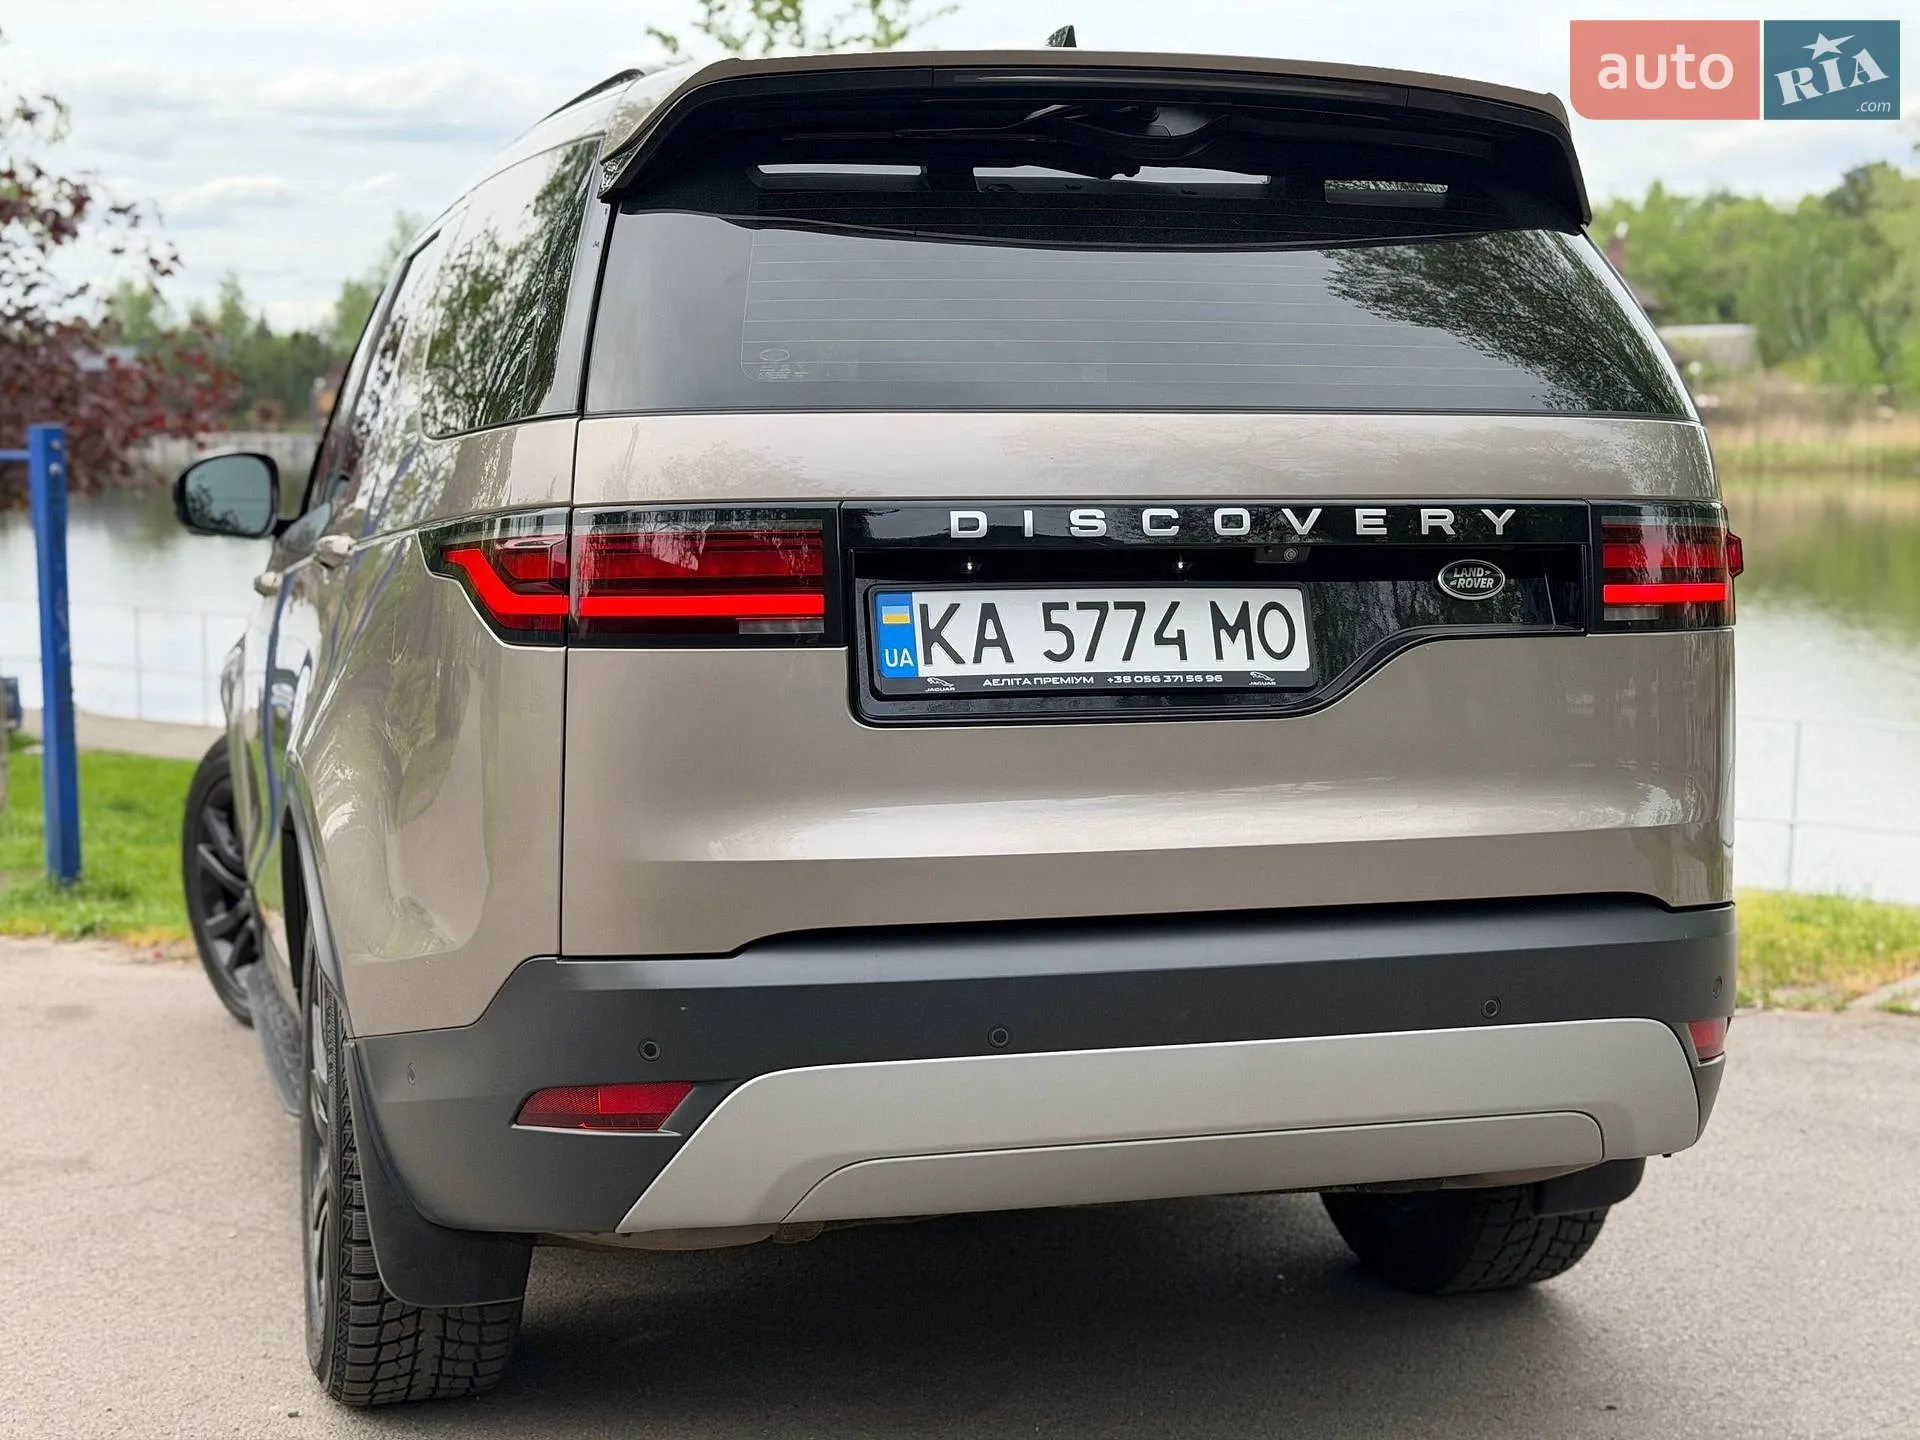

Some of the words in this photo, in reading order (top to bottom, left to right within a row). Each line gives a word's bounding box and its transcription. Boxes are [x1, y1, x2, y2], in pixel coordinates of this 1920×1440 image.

[950, 508, 1516, 539] DISCOVERY
[1453, 567, 1484, 578] LAND
[1457, 577, 1494, 589] ROVER
[918, 603, 1015, 666] KA
[1041, 601, 1188, 663] 5774
[1208, 600, 1296, 661] MO
[885, 652, 914, 668] UA
[983, 677, 1032, 687] АЕЛІТА
[1034, 676, 1094, 686] ПРЕМІУМ
[1107, 675, 1132, 684] +38
[1133, 675, 1161, 683] 056
[1163, 675, 1184, 683] 371
[1185, 674, 1203, 683] 56
[1205, 674, 1223, 682] 96
